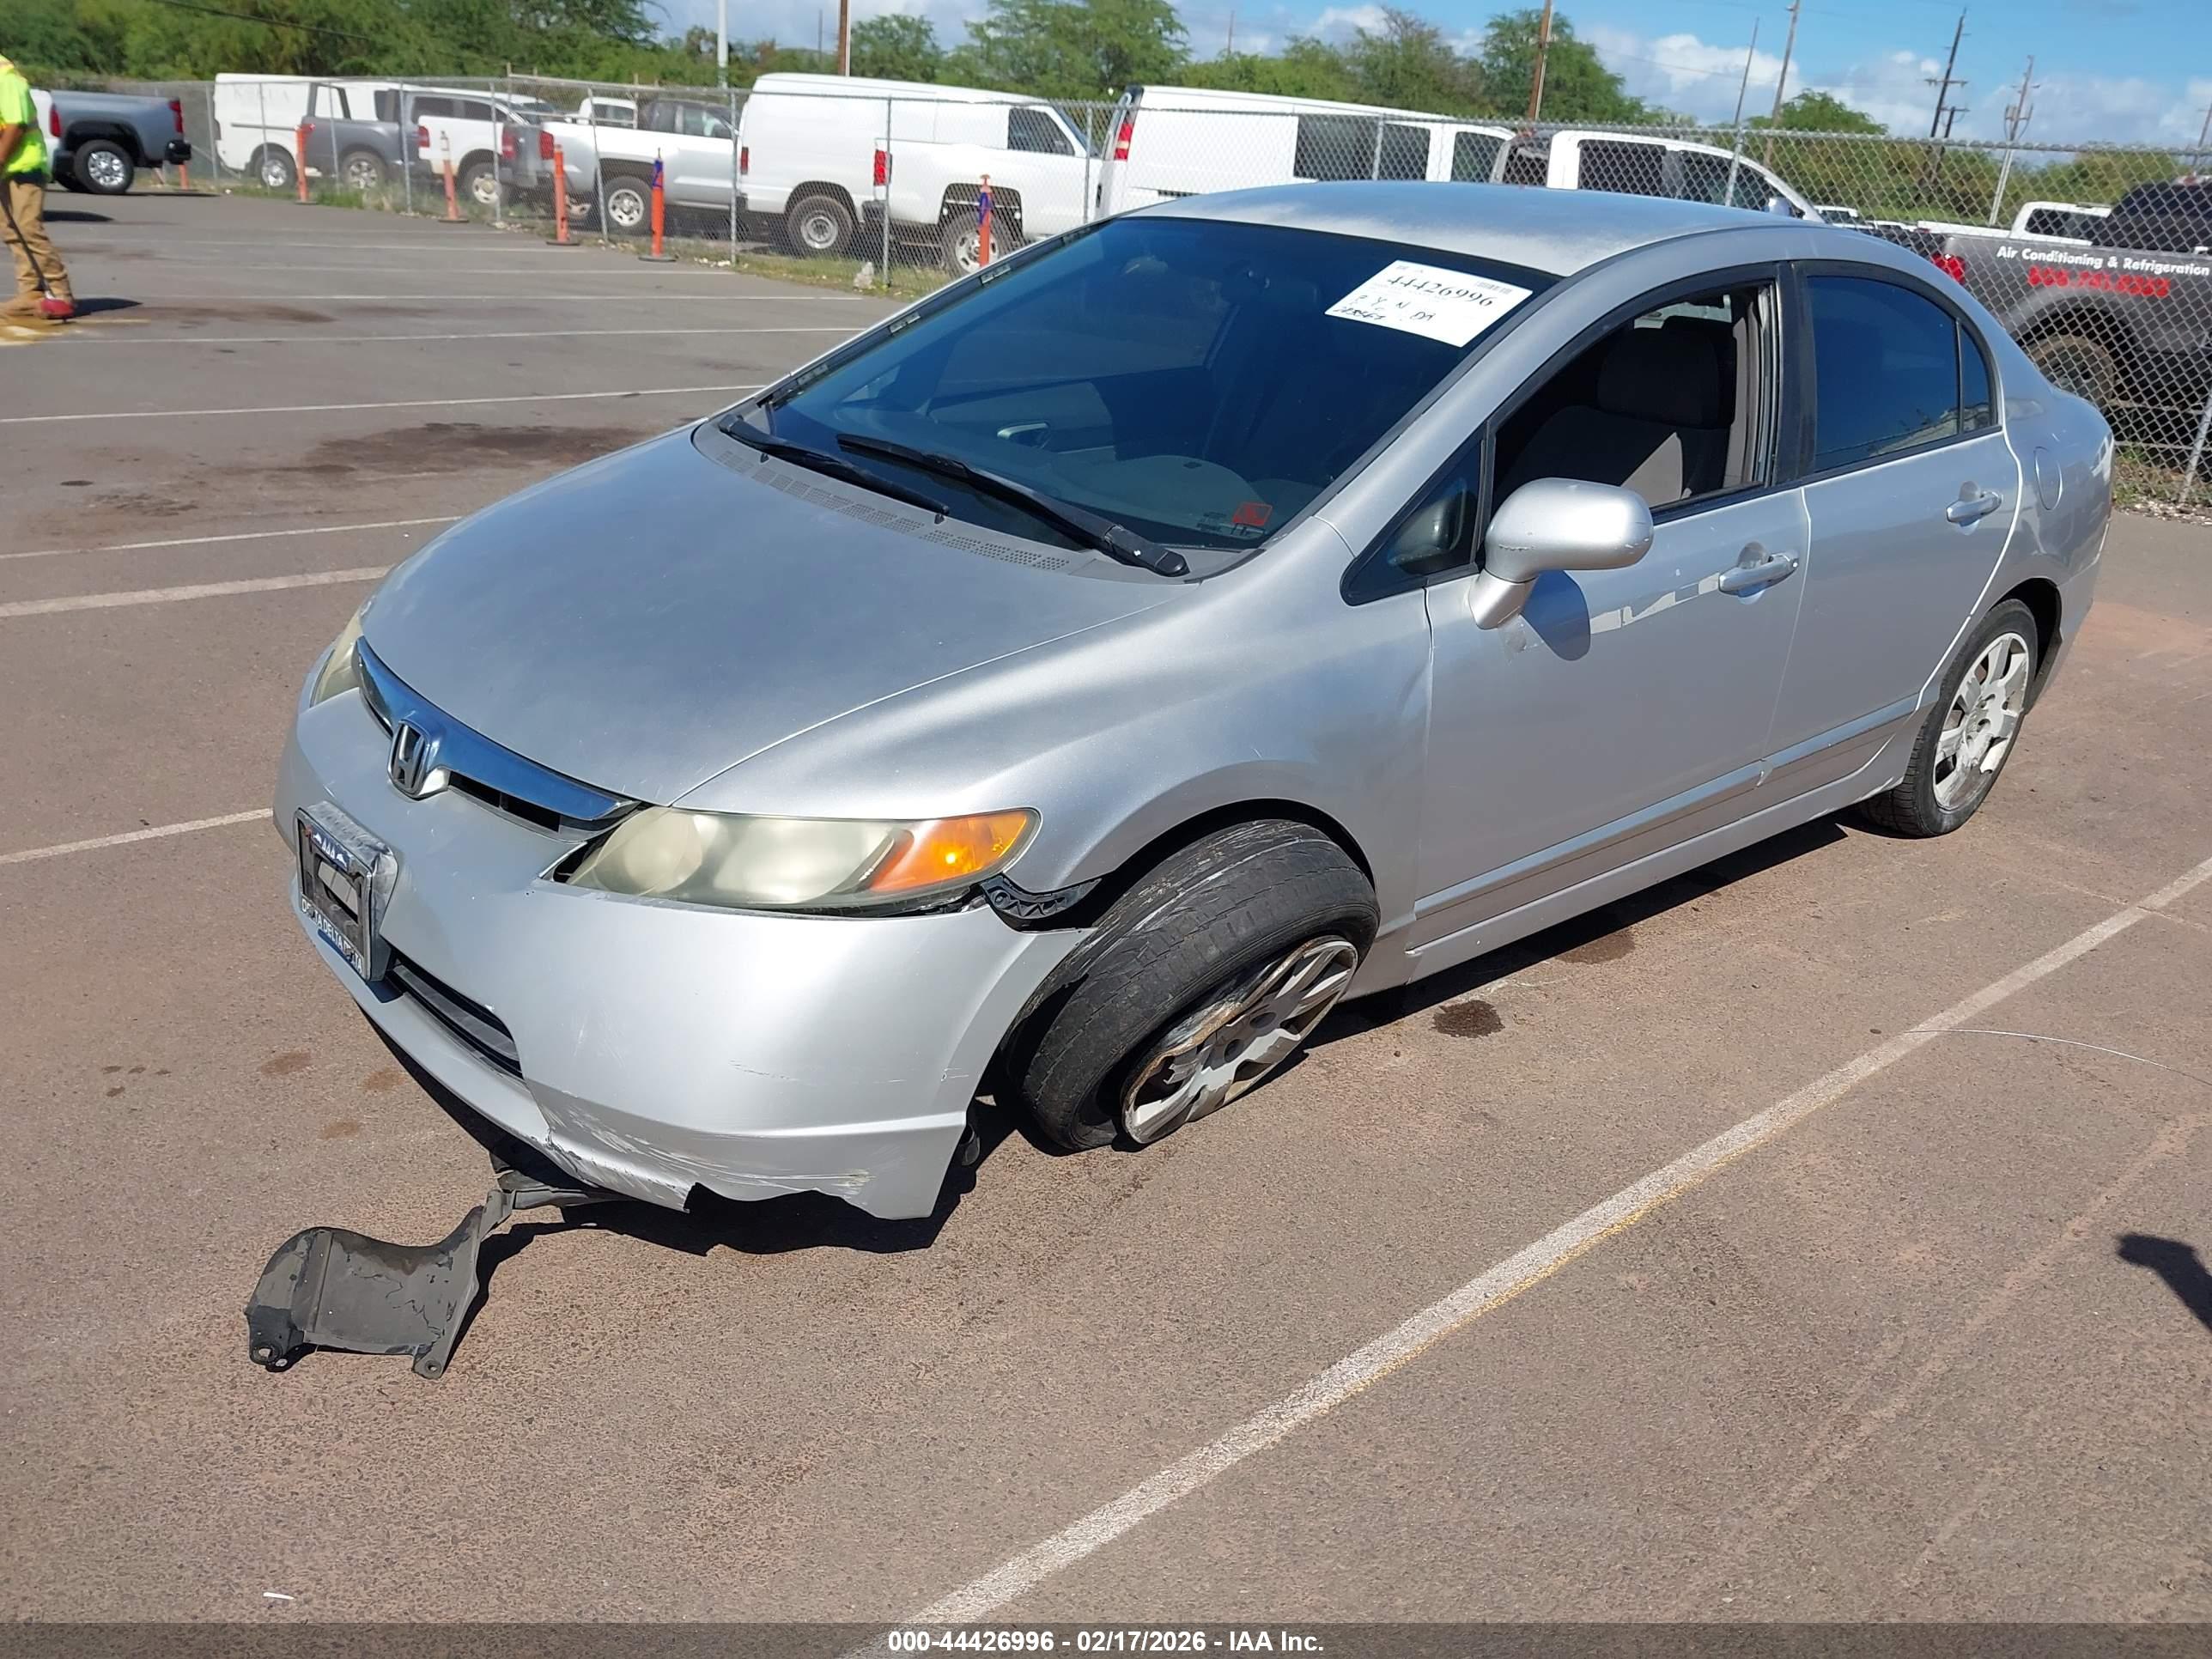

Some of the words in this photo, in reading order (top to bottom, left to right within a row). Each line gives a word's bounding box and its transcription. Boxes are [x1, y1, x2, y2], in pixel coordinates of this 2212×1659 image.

[1996, 246, 2018, 258] Air
[2021, 248, 2103, 269] Conditioning
[2107, 256, 2118, 268] &
[2123, 258, 2210, 276] Refrigeration
[1387, 276, 1494, 307] 44426996
[302, 898, 323, 929] DETA
[323, 918, 343, 951] DELTA
[343, 939, 362, 974] DETA
